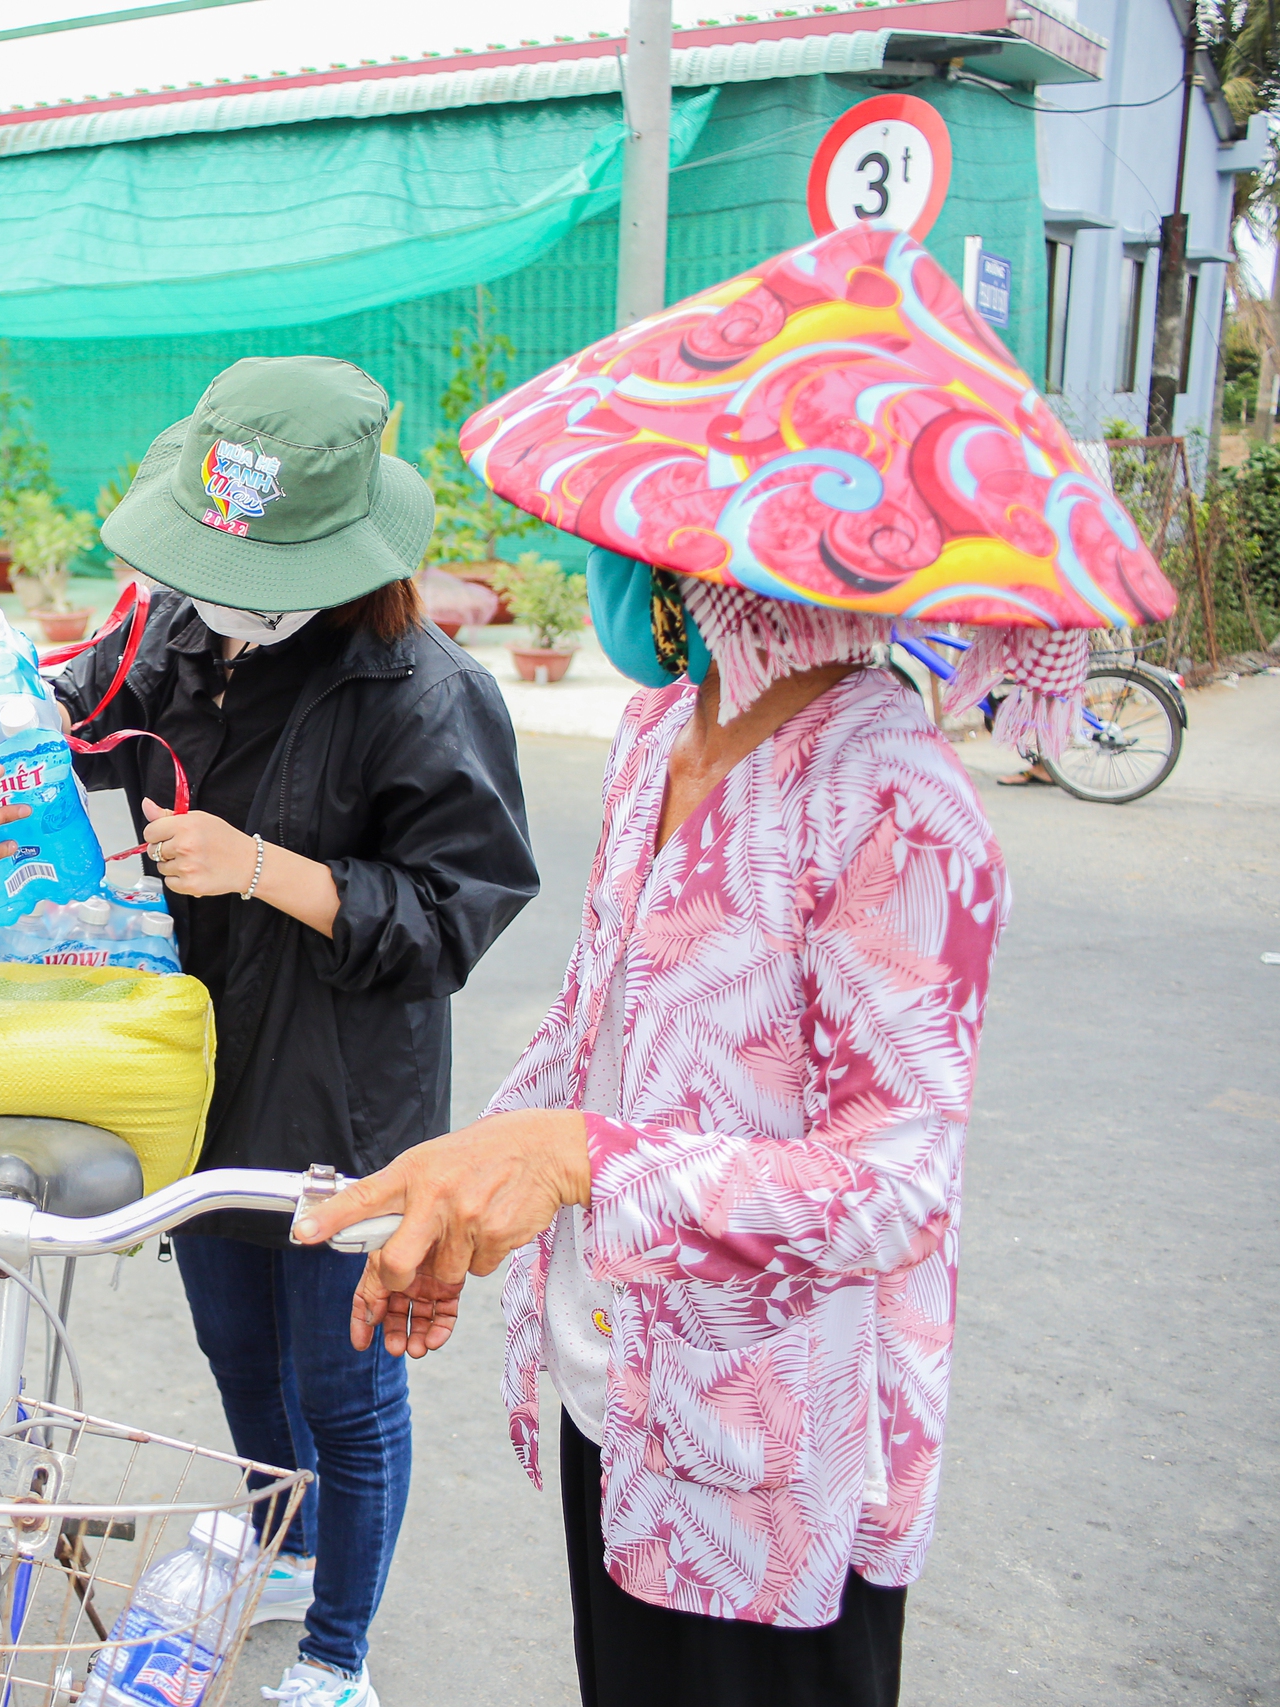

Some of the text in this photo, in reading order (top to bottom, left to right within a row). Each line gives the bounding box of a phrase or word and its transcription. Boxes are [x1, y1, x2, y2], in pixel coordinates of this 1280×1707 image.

[854, 152, 890, 221] 3
[218, 441, 252, 467] MÙA
[213, 457, 272, 492] XANH
[205, 512, 246, 536] 2022
